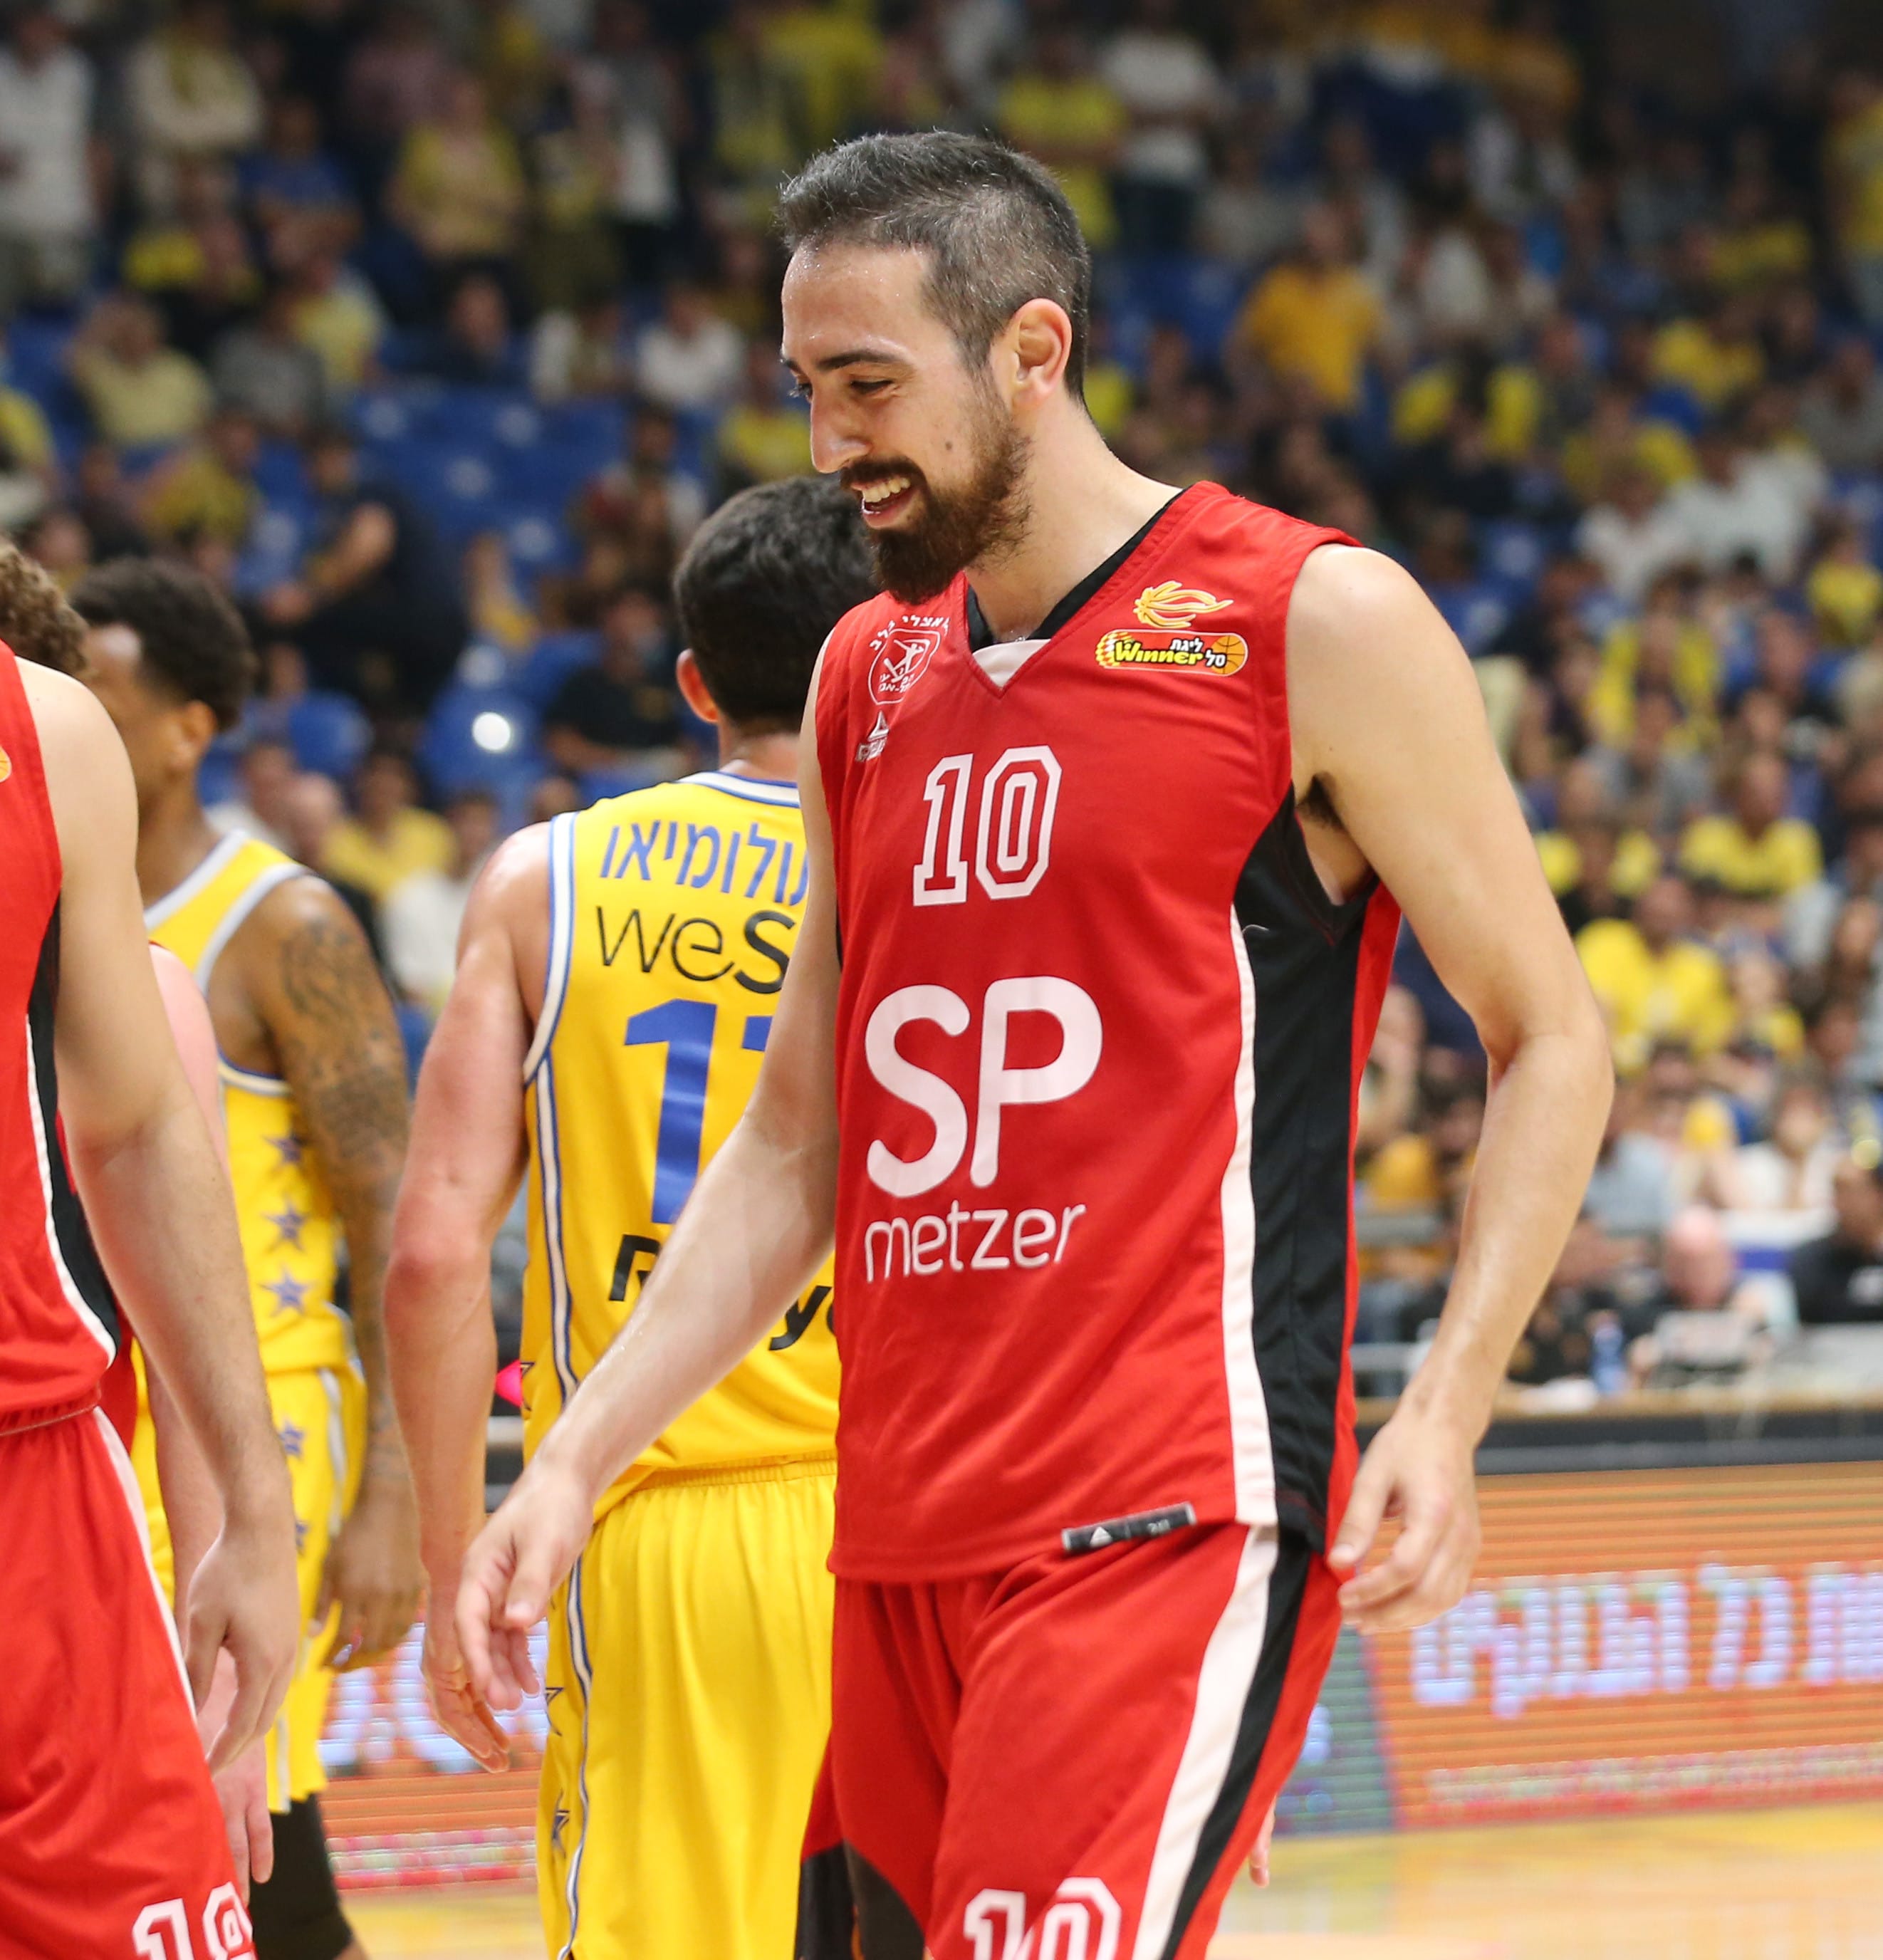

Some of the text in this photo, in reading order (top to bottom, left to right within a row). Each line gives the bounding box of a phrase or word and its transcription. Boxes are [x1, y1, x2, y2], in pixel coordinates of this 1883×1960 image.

[1114, 641, 1204, 665] Winner
[1170, 638, 1203, 652] ליגת
[1205, 650, 1226, 667] סל
[913, 745, 1063, 907] 10
[624, 999, 773, 1224] 1
[865, 975, 1103, 1198] SP
[864, 1199, 1087, 1283] metzer
[963, 1876, 1122, 1960] 10
